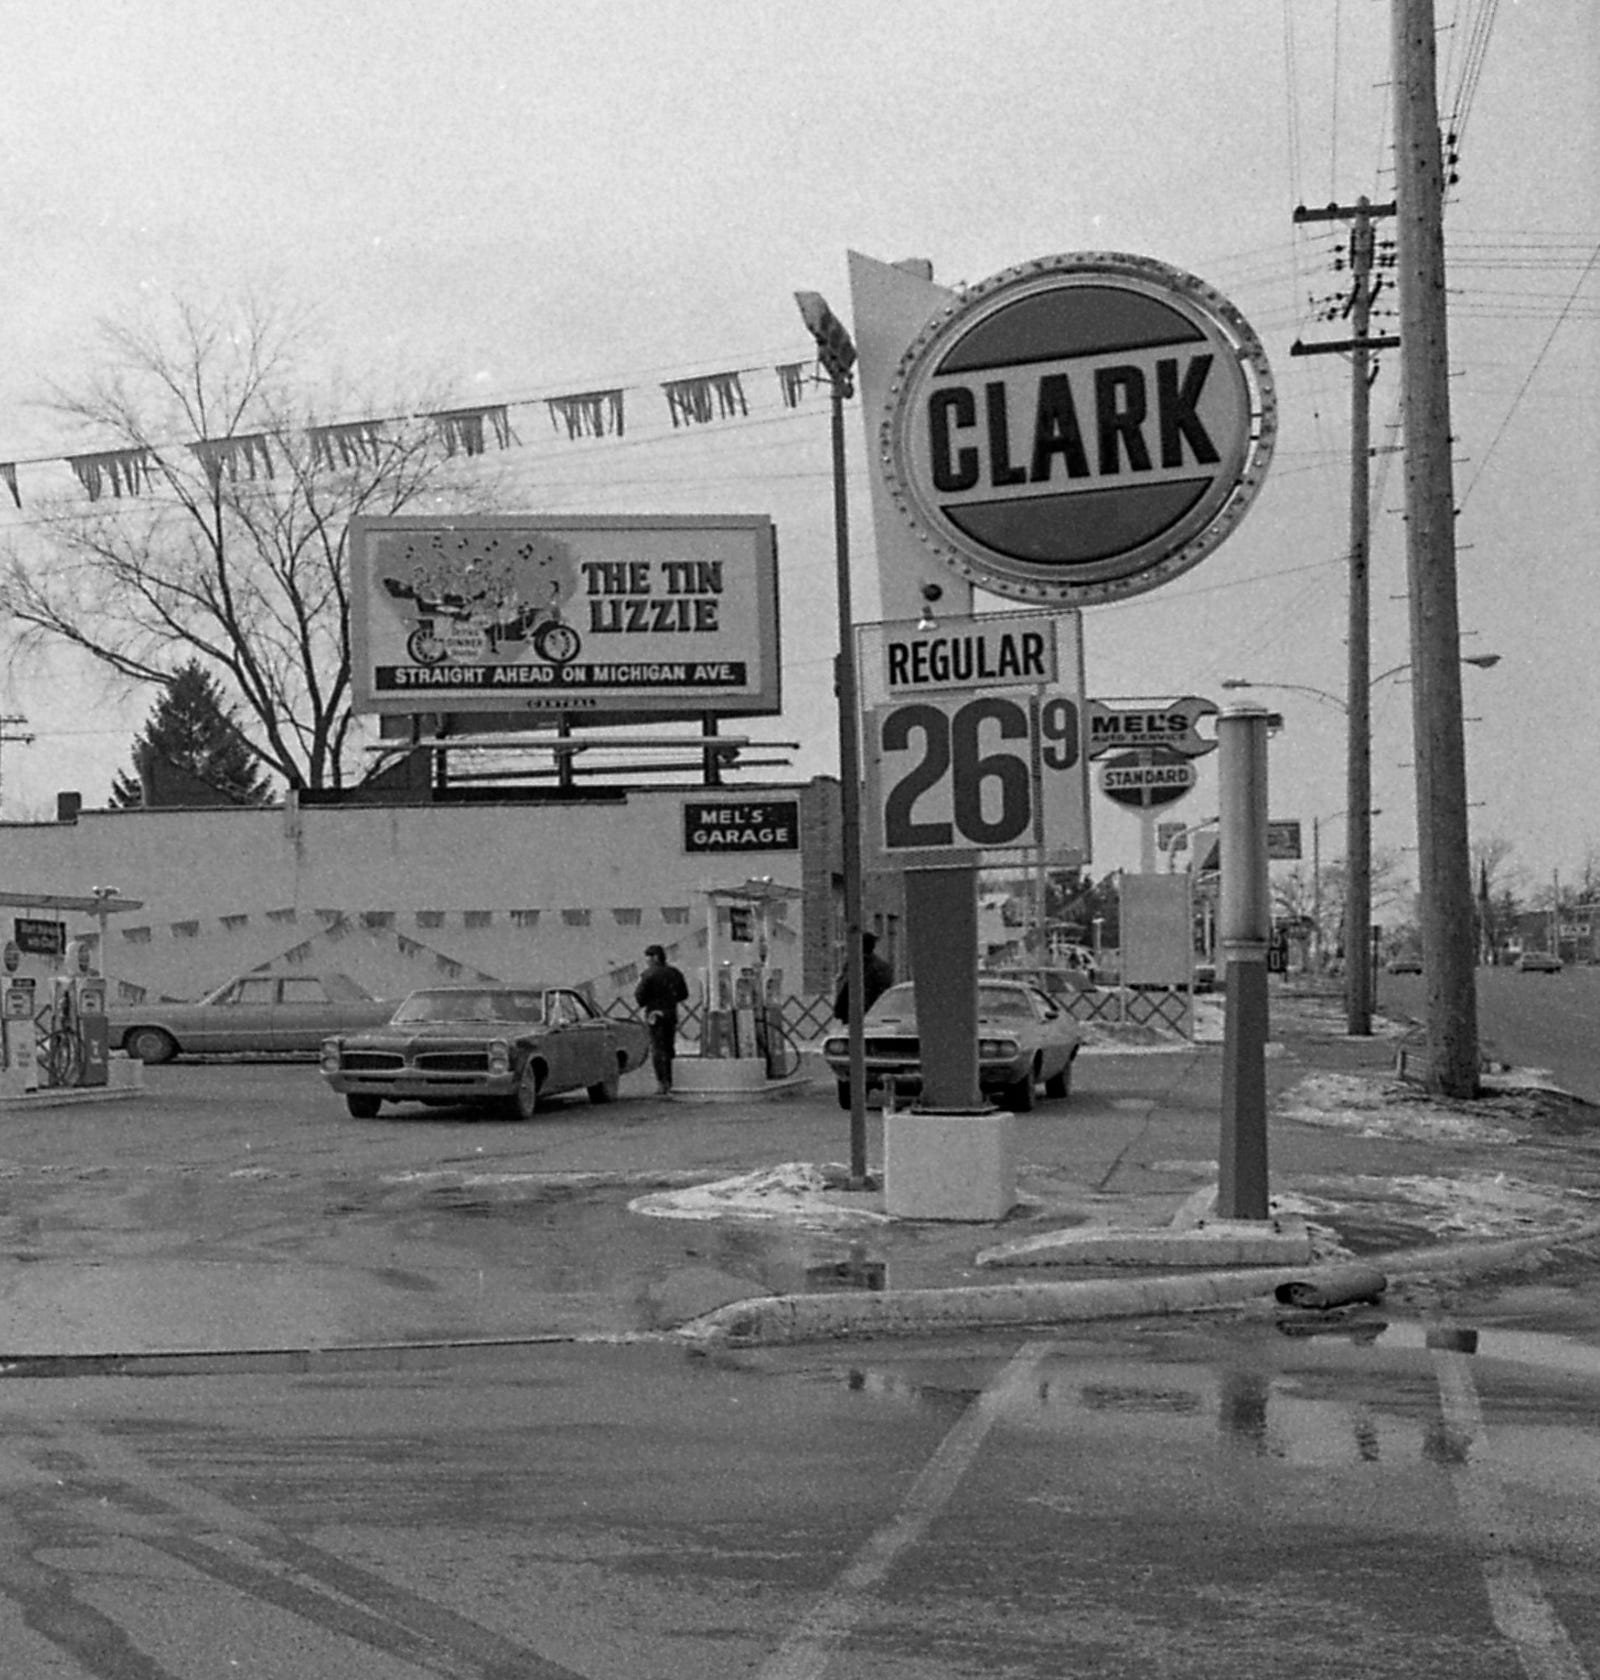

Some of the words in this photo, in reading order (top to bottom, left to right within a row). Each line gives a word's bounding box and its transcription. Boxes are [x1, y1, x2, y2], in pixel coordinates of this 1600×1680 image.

[927, 354, 1221, 493] CLARK
[581, 561, 650, 595] THE
[661, 561, 724, 594] TIN
[589, 599, 719, 633] LIZZIE
[888, 632, 1045, 686] REGULAR
[394, 667, 487, 685] STRAIGHT
[492, 666, 555, 684] AHEAD
[561, 665, 586, 682] ON
[593, 664, 686, 682] MICHIGAN
[694, 664, 736, 681] AVE.
[1091, 713, 1189, 733] MEL'S
[1091, 733, 1126, 742] AUTO
[1130, 732, 1187, 741] SERVICE
[1104, 768, 1189, 787] STANDARD
[700, 806, 764, 824] MEL'S
[693, 828, 789, 844] GARAGE
